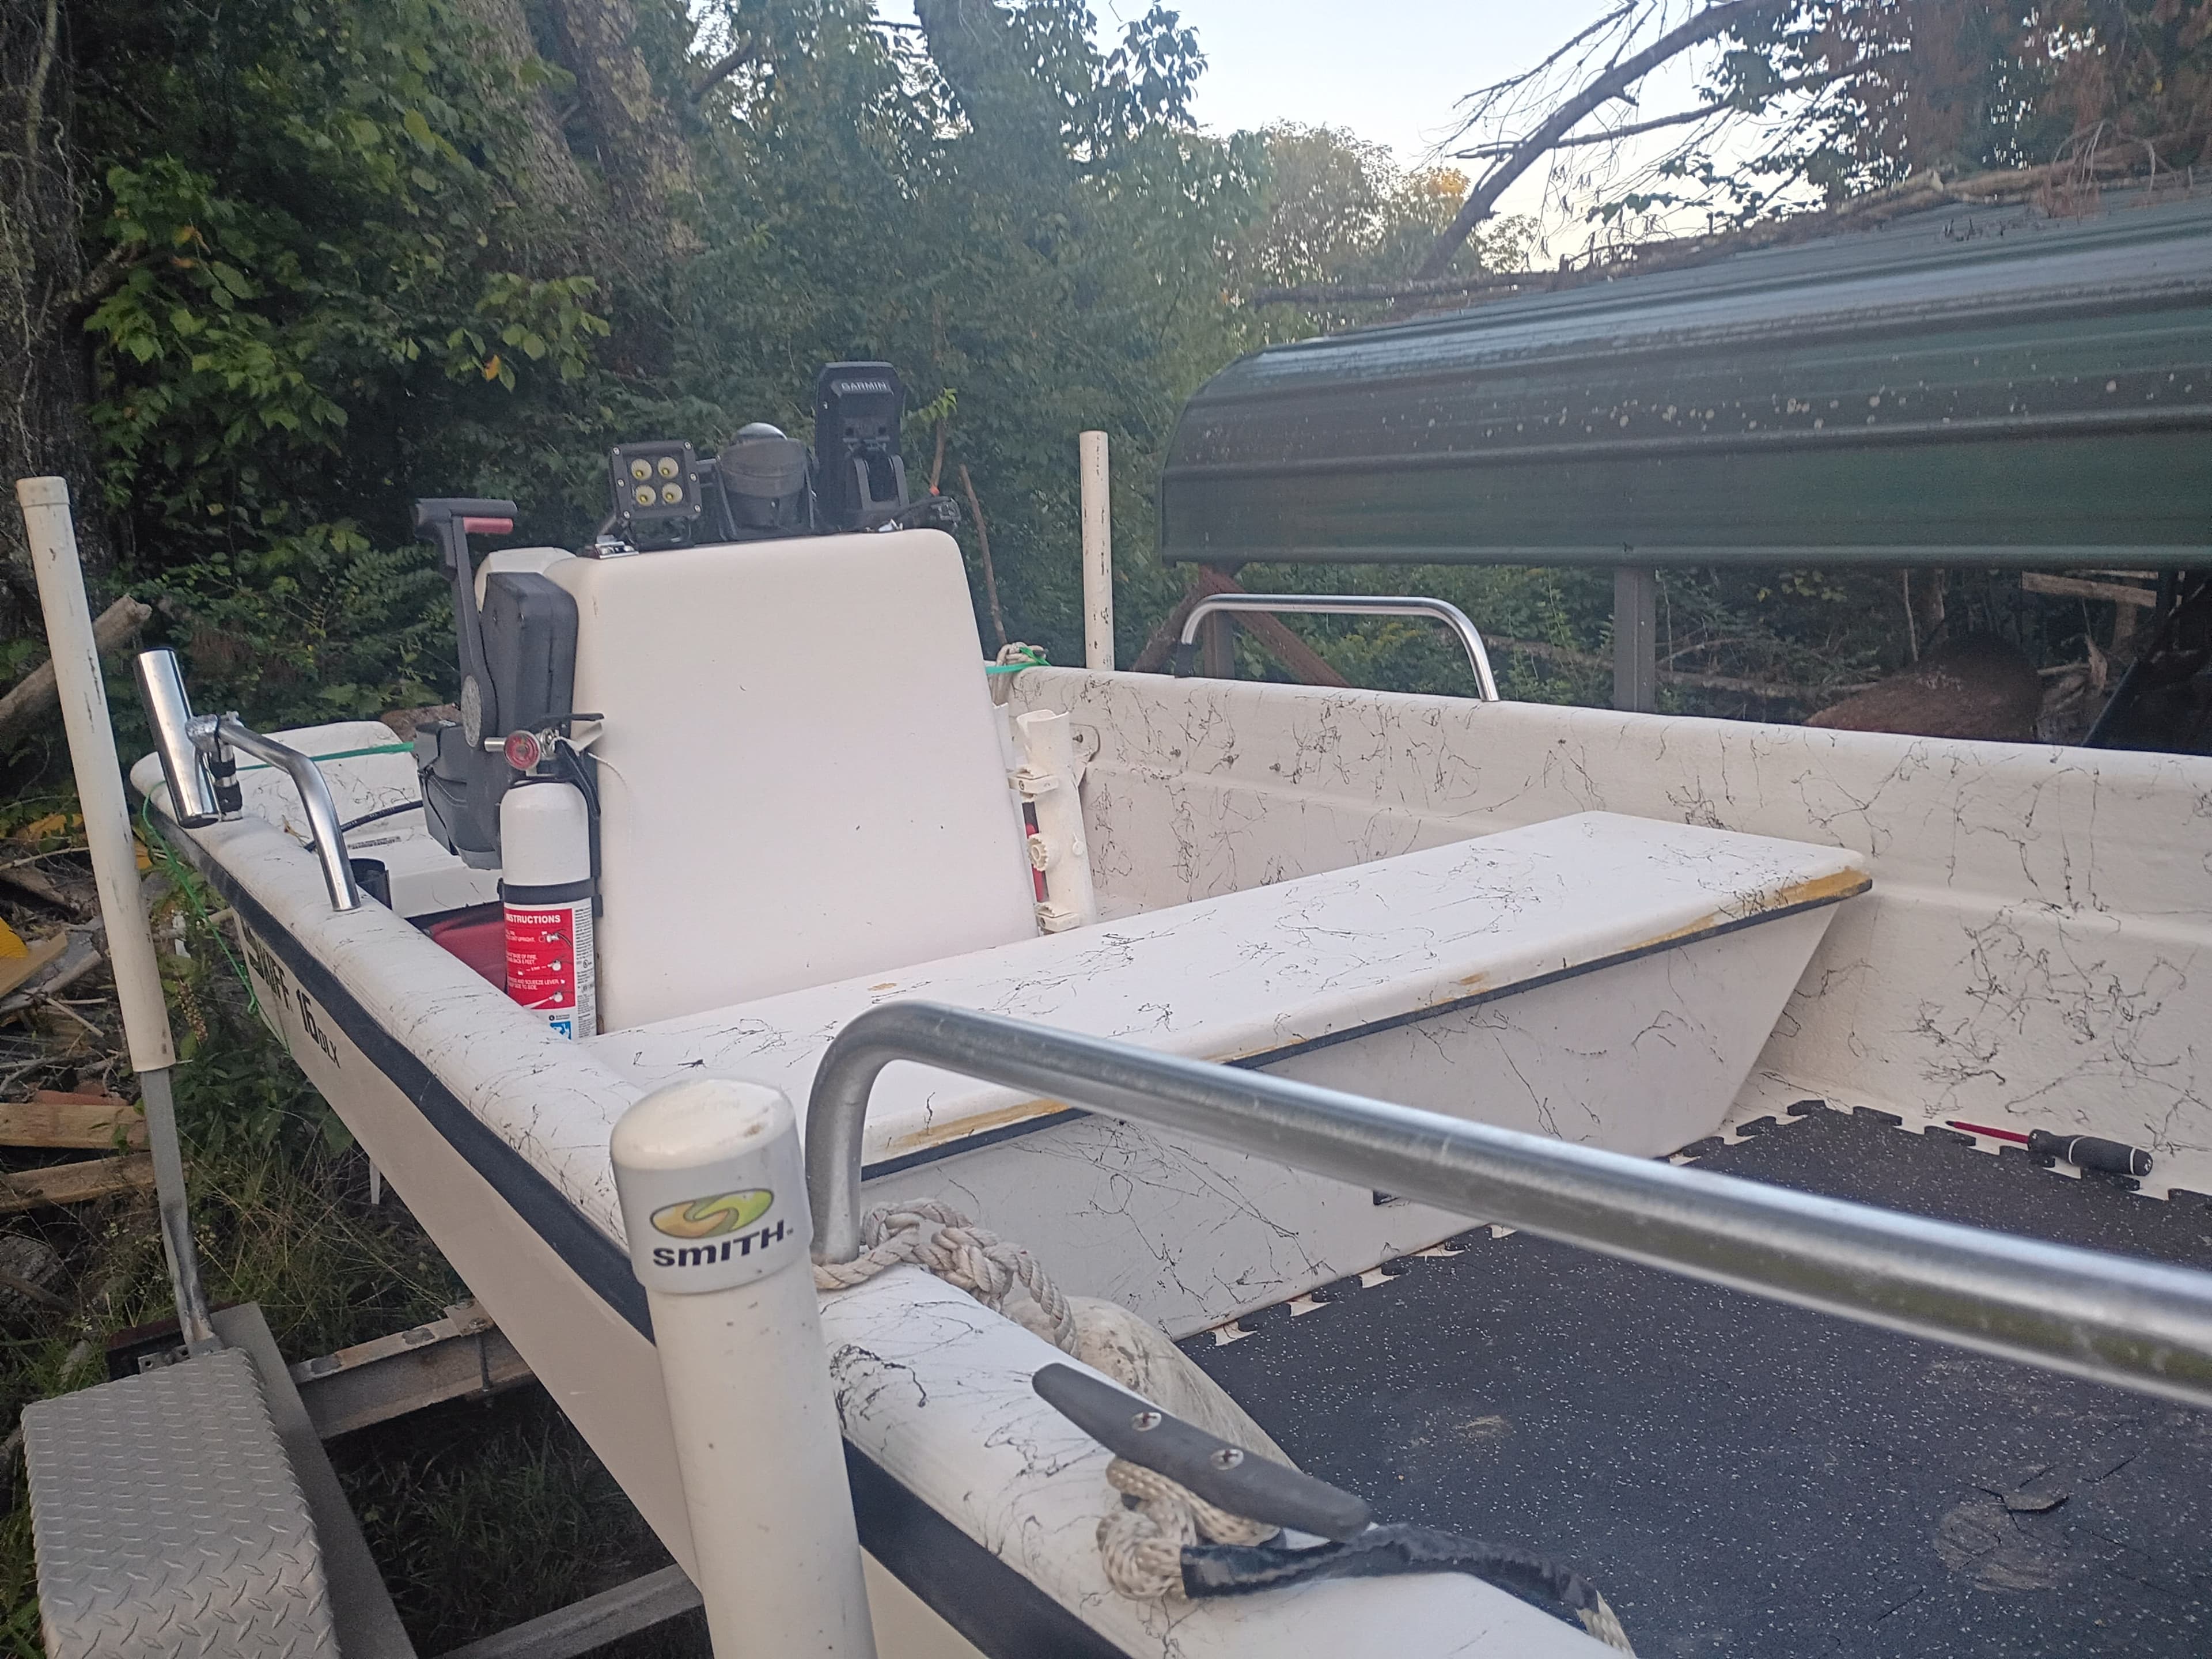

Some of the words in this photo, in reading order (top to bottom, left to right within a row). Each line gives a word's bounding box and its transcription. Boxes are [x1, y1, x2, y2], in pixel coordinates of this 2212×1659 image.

[841, 381, 887, 392] GARMIN
[296, 988, 319, 1044] 16
[317, 1027, 341, 1069] DLX
[653, 1219, 785, 1267] SMITH
